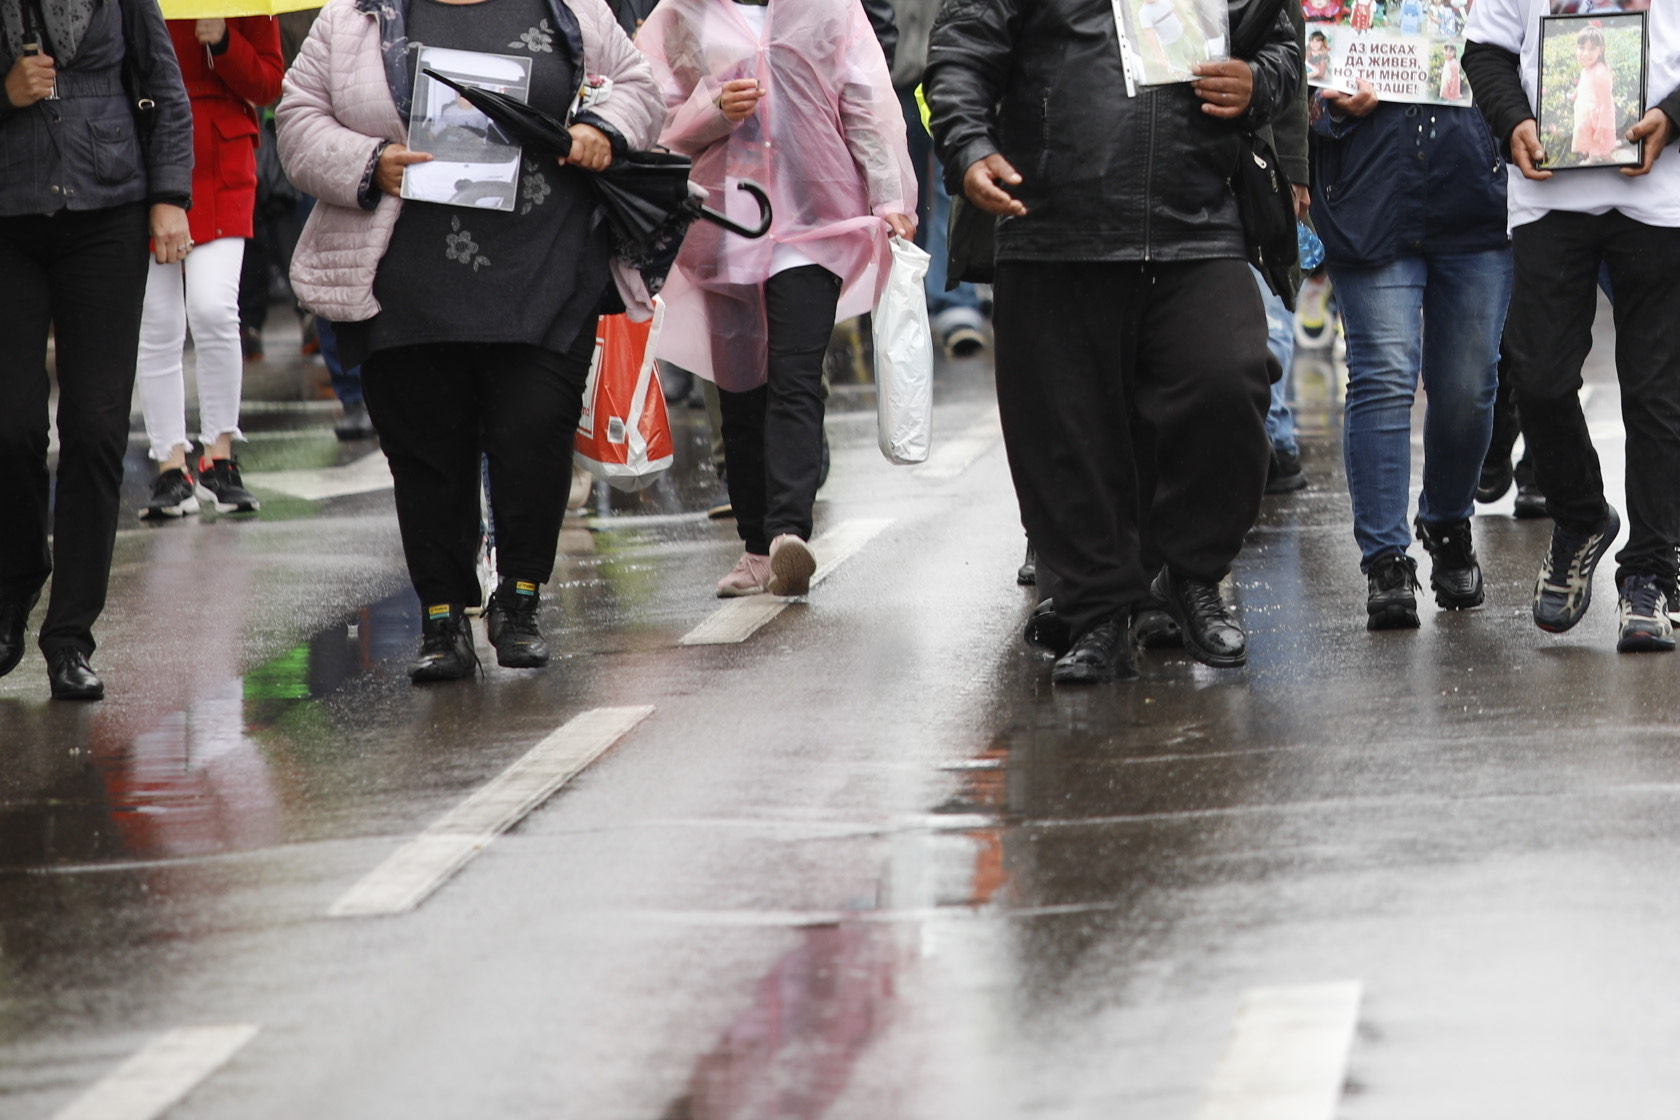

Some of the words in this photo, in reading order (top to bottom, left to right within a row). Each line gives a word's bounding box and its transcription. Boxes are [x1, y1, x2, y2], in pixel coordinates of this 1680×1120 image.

[1349, 43, 1366, 54] АЗ
[1370, 43, 1416, 55] ИСКАХ
[1344, 56, 1364, 67] ДА
[1368, 56, 1421, 70] ЖИВЕЯ,
[1333, 67, 1353, 78] НО
[1357, 69, 1375, 79] ТИ
[1380, 70, 1427, 81] МНОГО
